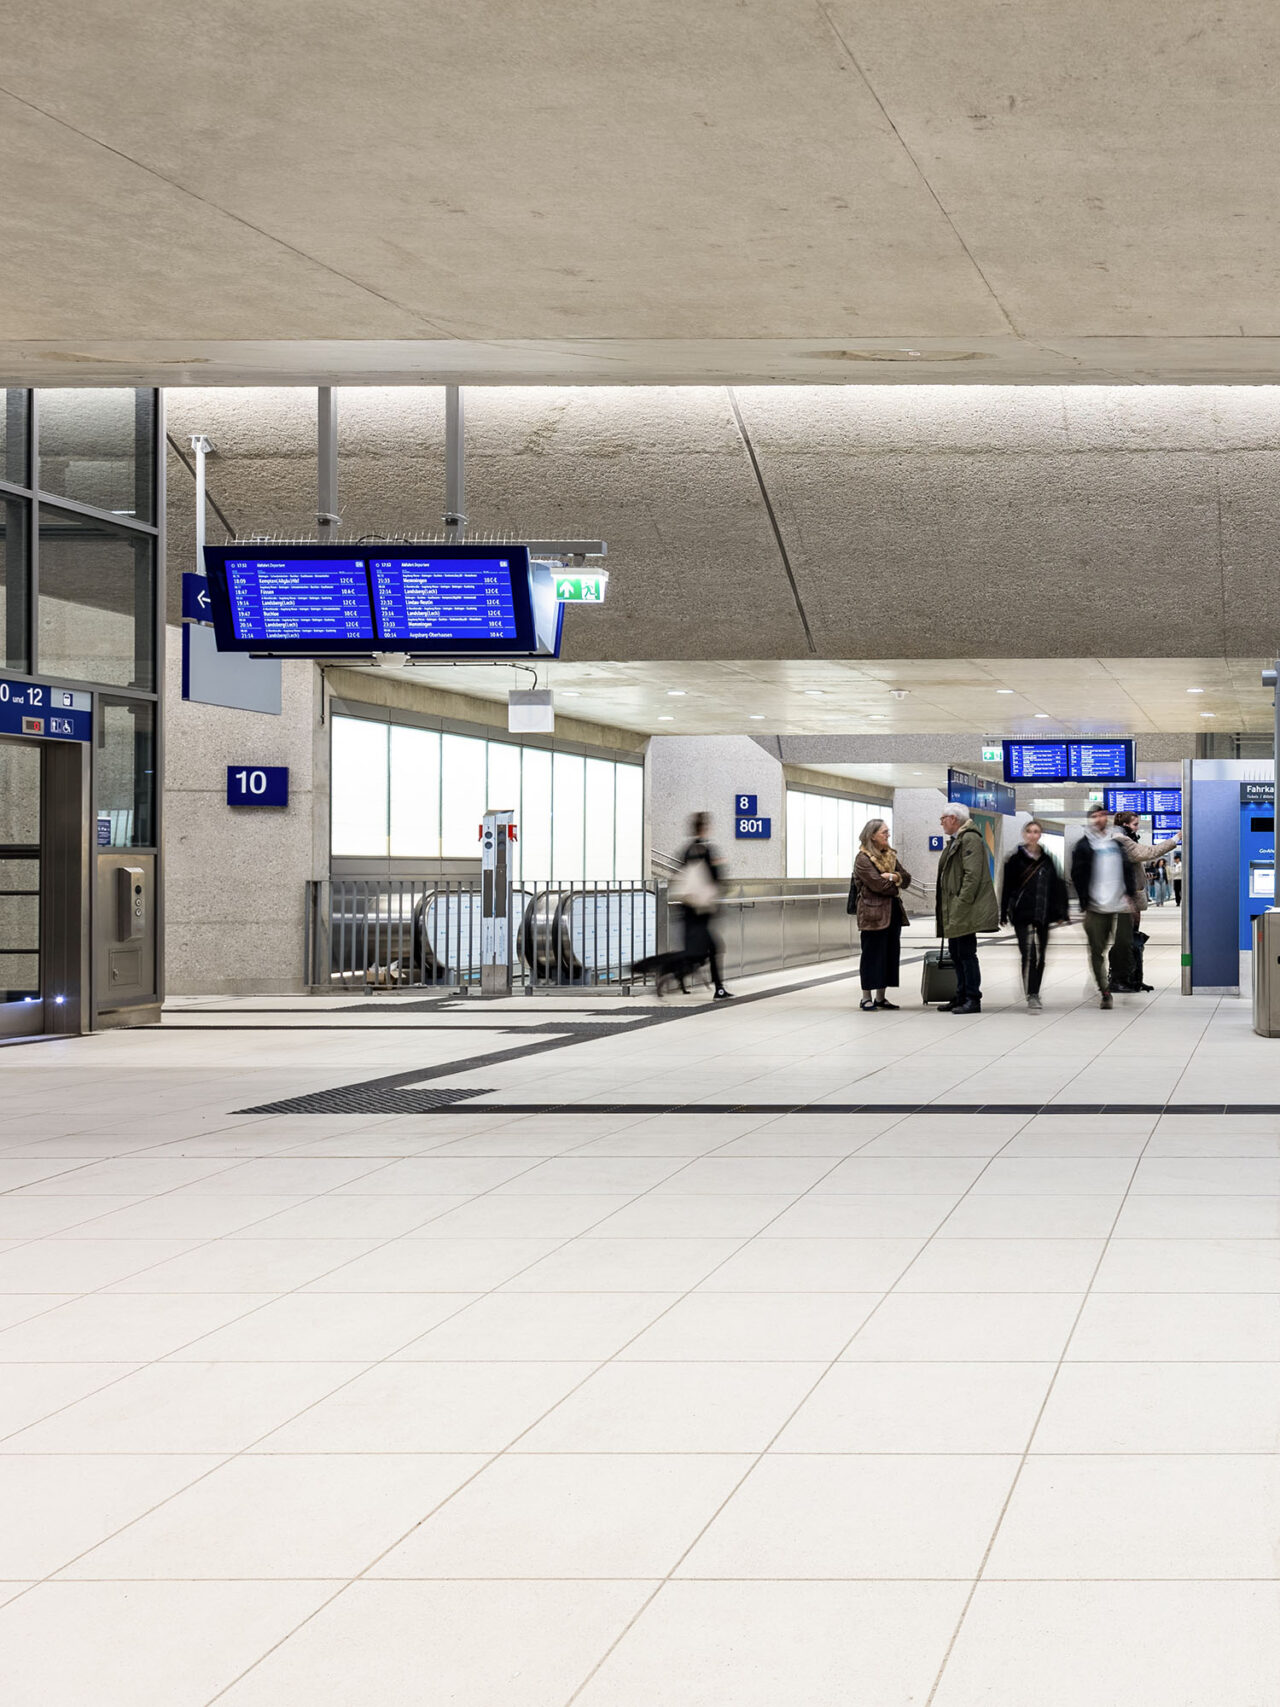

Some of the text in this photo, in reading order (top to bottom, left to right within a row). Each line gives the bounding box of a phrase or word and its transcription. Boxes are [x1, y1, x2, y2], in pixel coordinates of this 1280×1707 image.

[0, 684, 43, 706] 0 und 12
[235, 770, 267, 794] 10
[1246, 785, 1275, 793] Fahrka
[740, 796, 749, 809] 8
[740, 819, 762, 832] 801
[931, 837, 938, 846] 6
